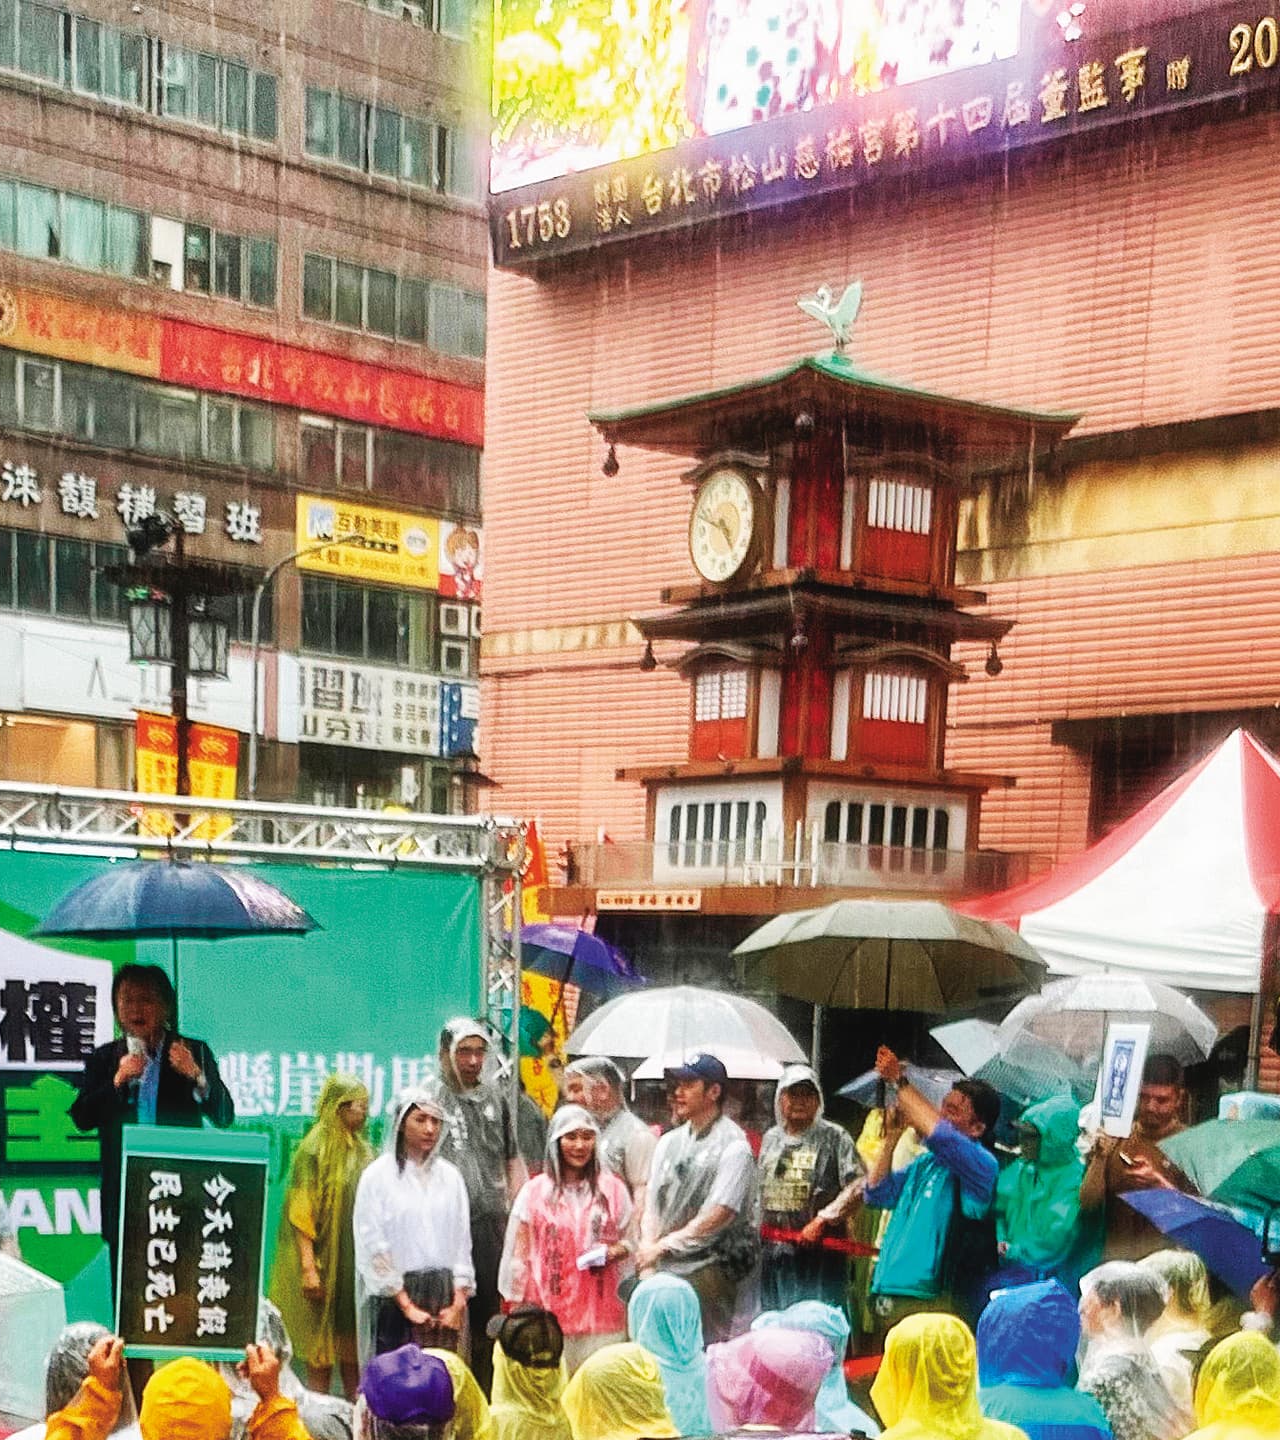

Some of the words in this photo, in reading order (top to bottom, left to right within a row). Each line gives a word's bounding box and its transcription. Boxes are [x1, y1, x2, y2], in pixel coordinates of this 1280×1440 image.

[143, 1170, 183, 1334] 民主已死亡
